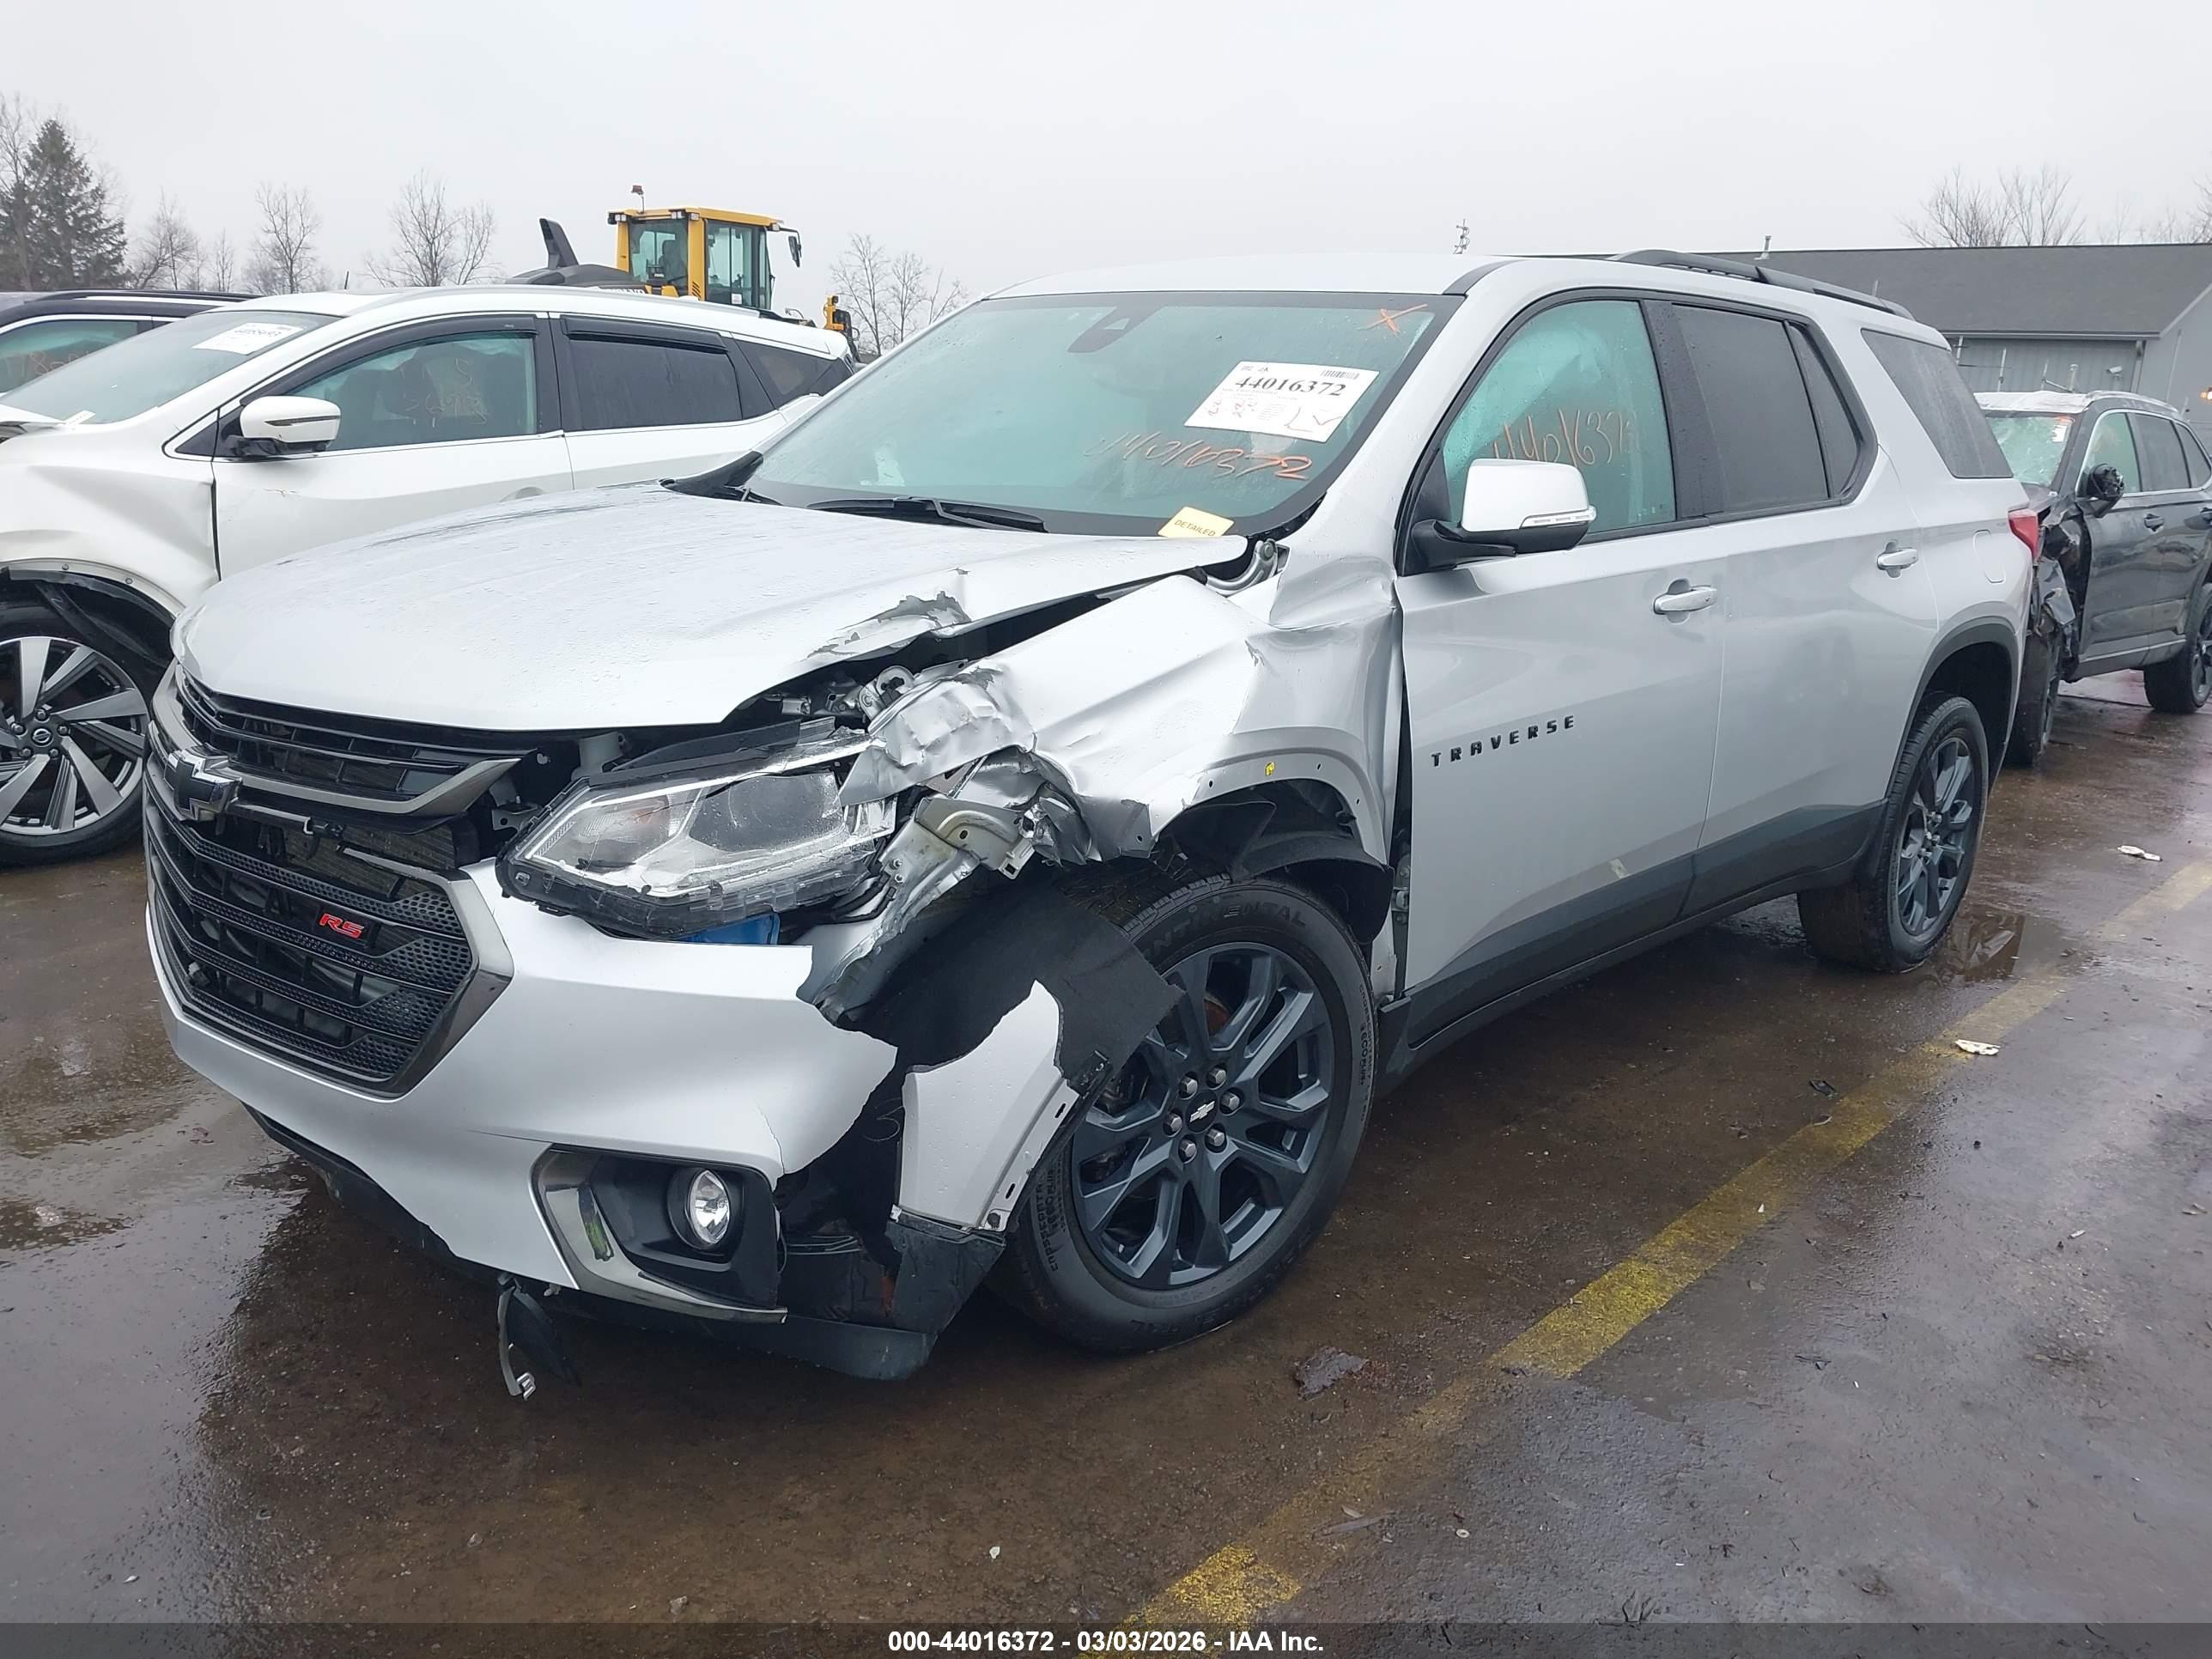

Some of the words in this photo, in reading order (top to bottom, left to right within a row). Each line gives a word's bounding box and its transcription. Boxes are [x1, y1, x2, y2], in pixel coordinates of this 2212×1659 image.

[1235, 376, 1346, 396] 44016372
[1173, 520, 1217, 538] DETAILED
[1431, 715, 1574, 767] TRAVERSE
[319, 913, 364, 939] RS
